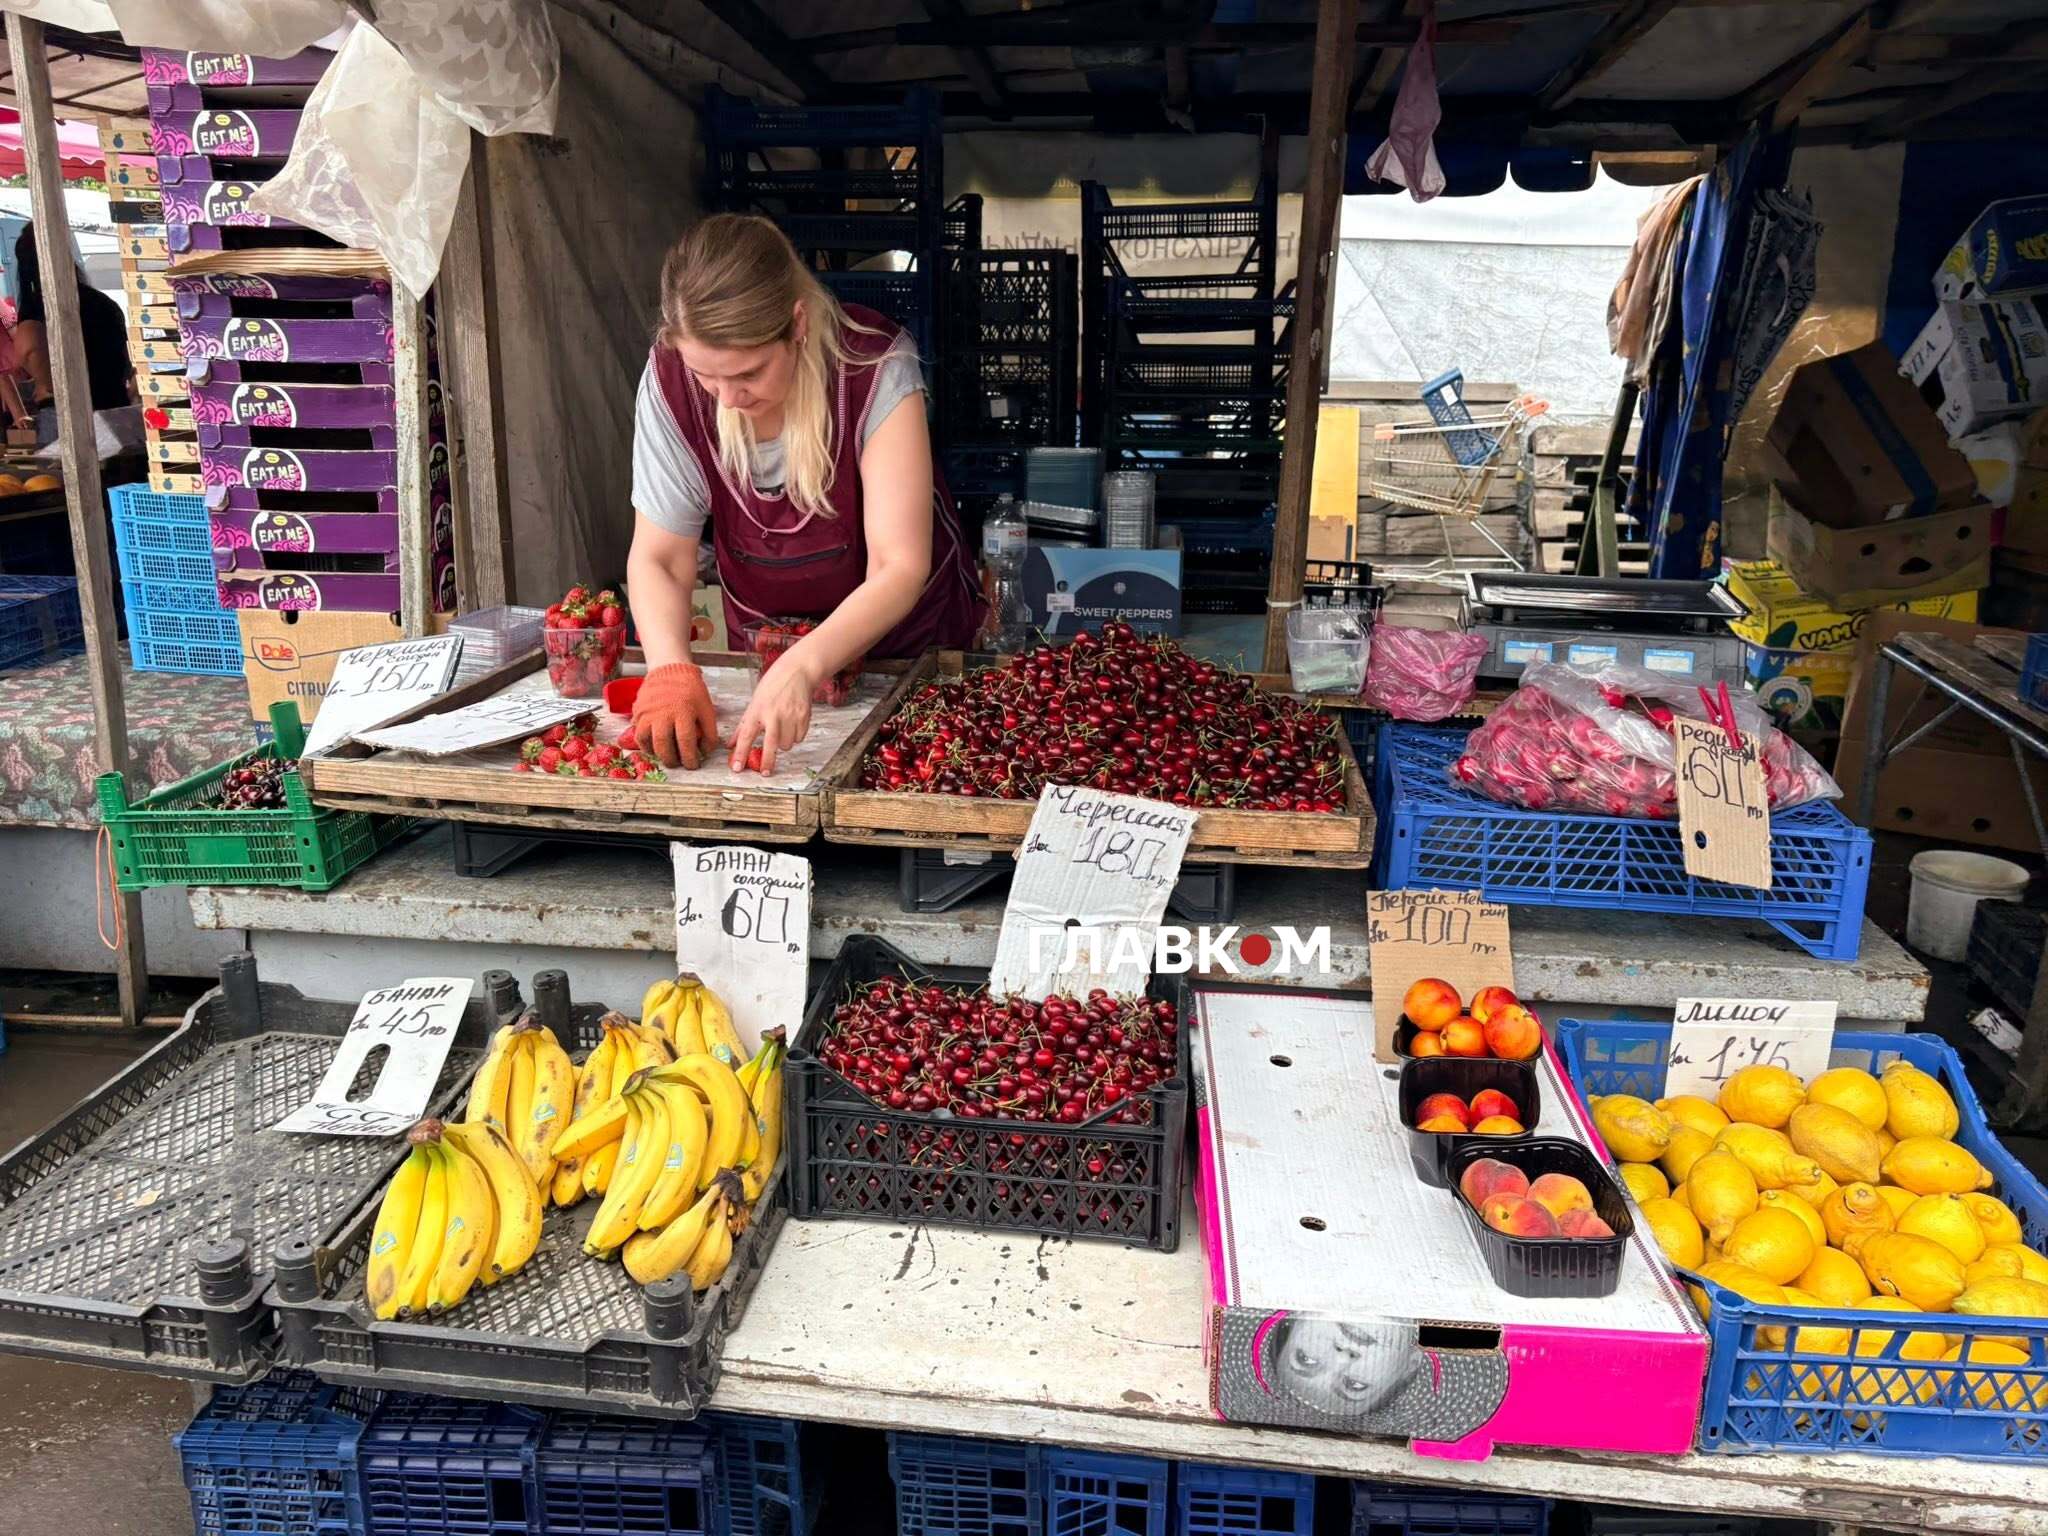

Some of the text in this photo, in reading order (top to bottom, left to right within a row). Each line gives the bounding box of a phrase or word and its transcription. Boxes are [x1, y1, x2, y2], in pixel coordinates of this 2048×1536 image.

[195, 54, 243, 77] EAT ME
[200, 126, 249, 147] EAT ME
[212, 202, 238, 218] EAT
[213, 278, 262, 290] EAT ME
[231, 333, 279, 352] EAT ME
[239, 400, 287, 418] EAT ME
[250, 464, 297, 482] EAT ME
[259, 526, 305, 543] EAT ME
[266, 585, 313, 602] EAT ME
[1074, 607, 1173, 620] SWEET PEPPERS
[261, 644, 294, 657] Dole
[341, 639, 450, 667] Черешня
[1050, 787, 1187, 837] Черешня
[696, 850, 771, 873] БАНАН
[368, 984, 454, 1005] БАНАН
